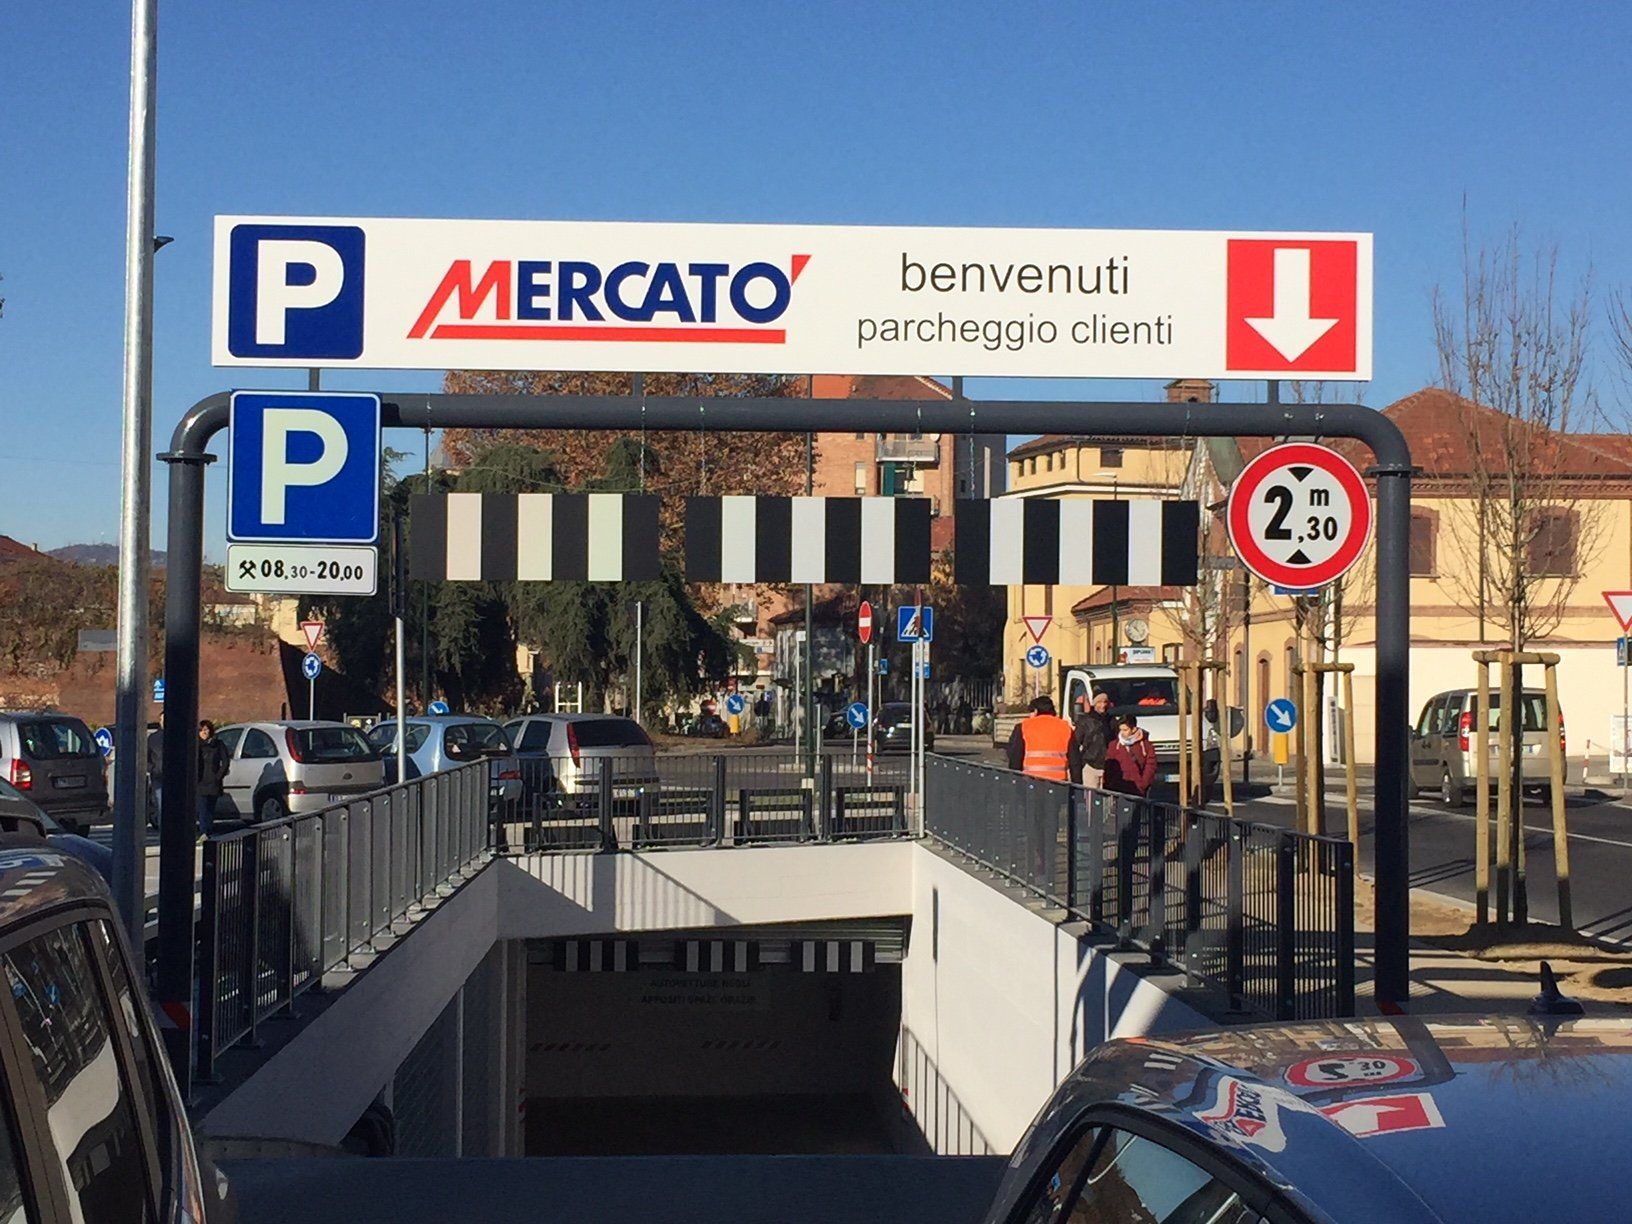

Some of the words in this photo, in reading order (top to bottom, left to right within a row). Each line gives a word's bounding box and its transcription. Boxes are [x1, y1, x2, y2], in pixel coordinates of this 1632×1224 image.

[255, 239, 345, 345] P
[901, 253, 1129, 294] benvenuti
[857, 312, 1058, 351] parcheggio
[1071, 314, 1172, 345] clienti
[260, 408, 349, 525] P
